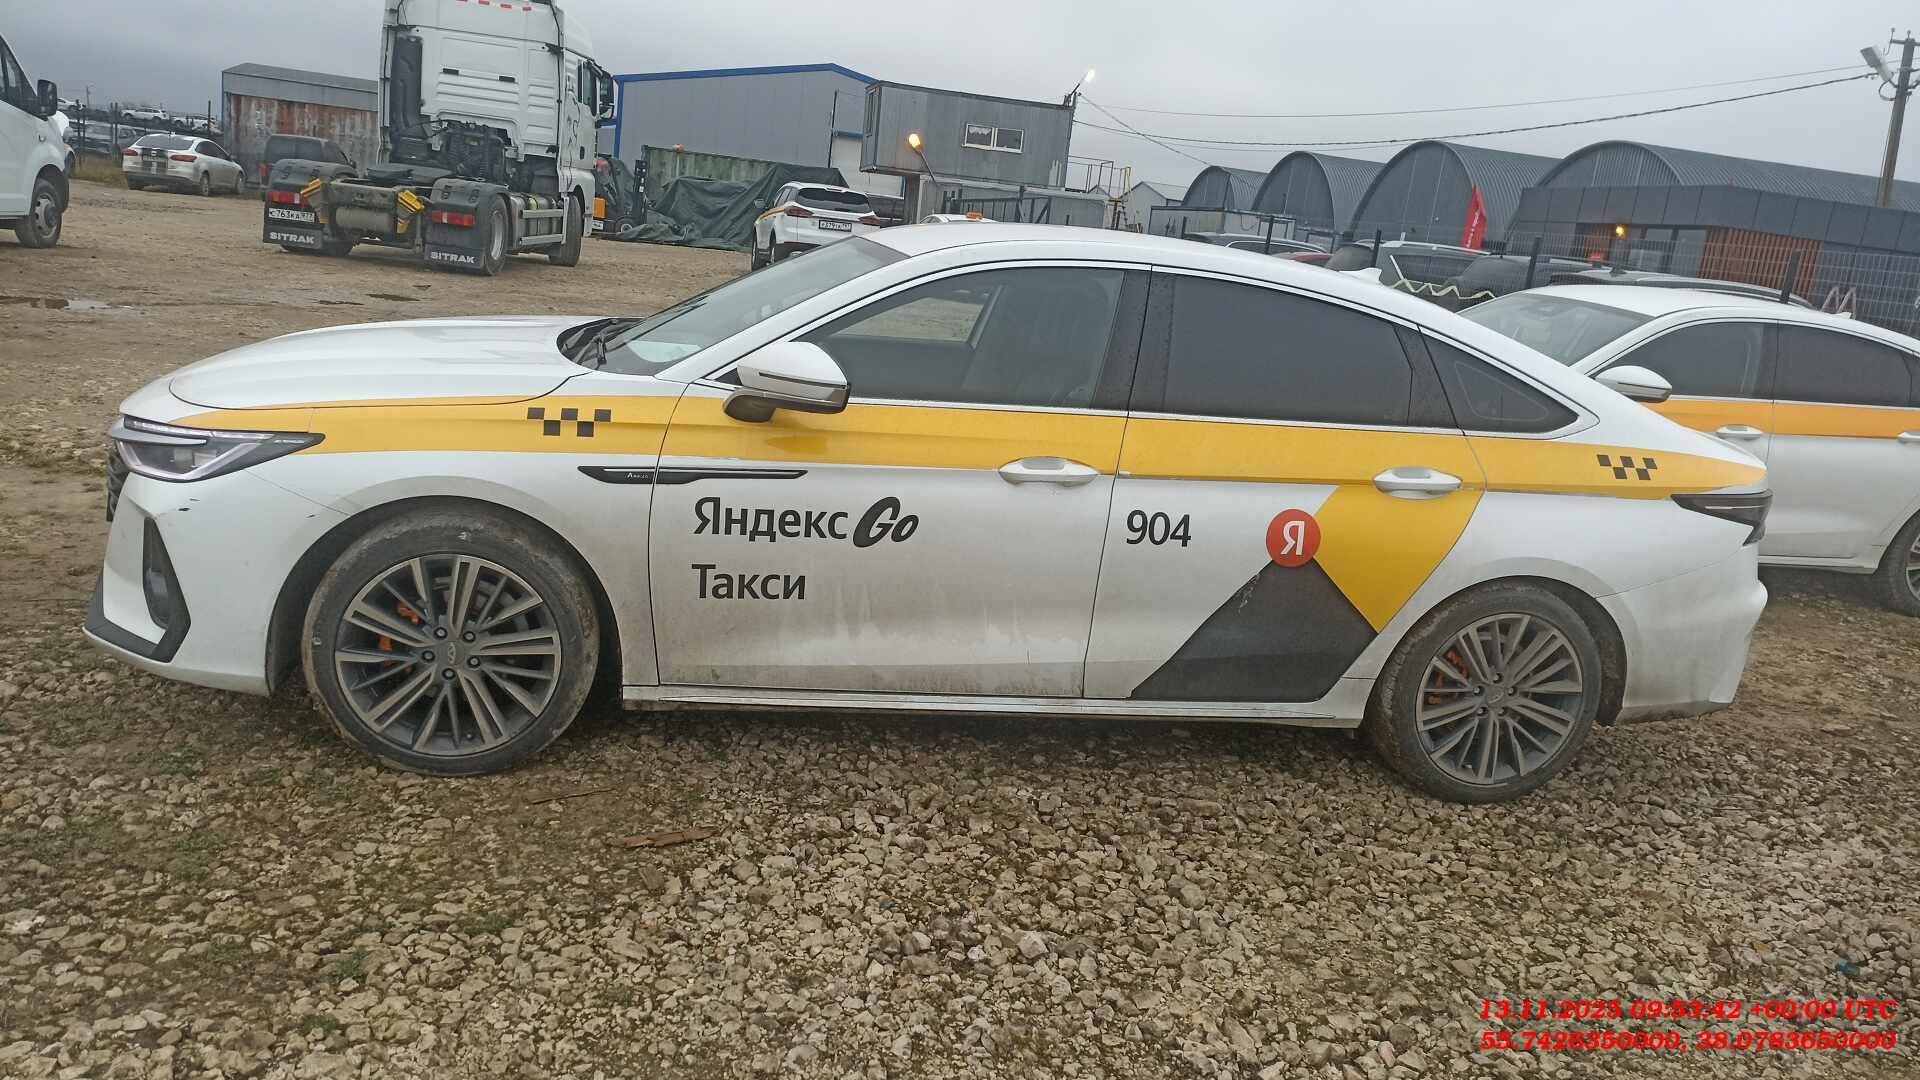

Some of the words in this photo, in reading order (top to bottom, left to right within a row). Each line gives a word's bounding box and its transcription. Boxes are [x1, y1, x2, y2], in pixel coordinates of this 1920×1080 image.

[269, 231, 315, 244] SITRAK
[430, 251, 475, 264] SITRAK
[693, 496, 849, 542] Яндекс
[852, 496, 919, 548] Go
[1126, 509, 1192, 548] 904
[1280, 520, 1305, 556] Я
[691, 563, 806, 600] Такси
